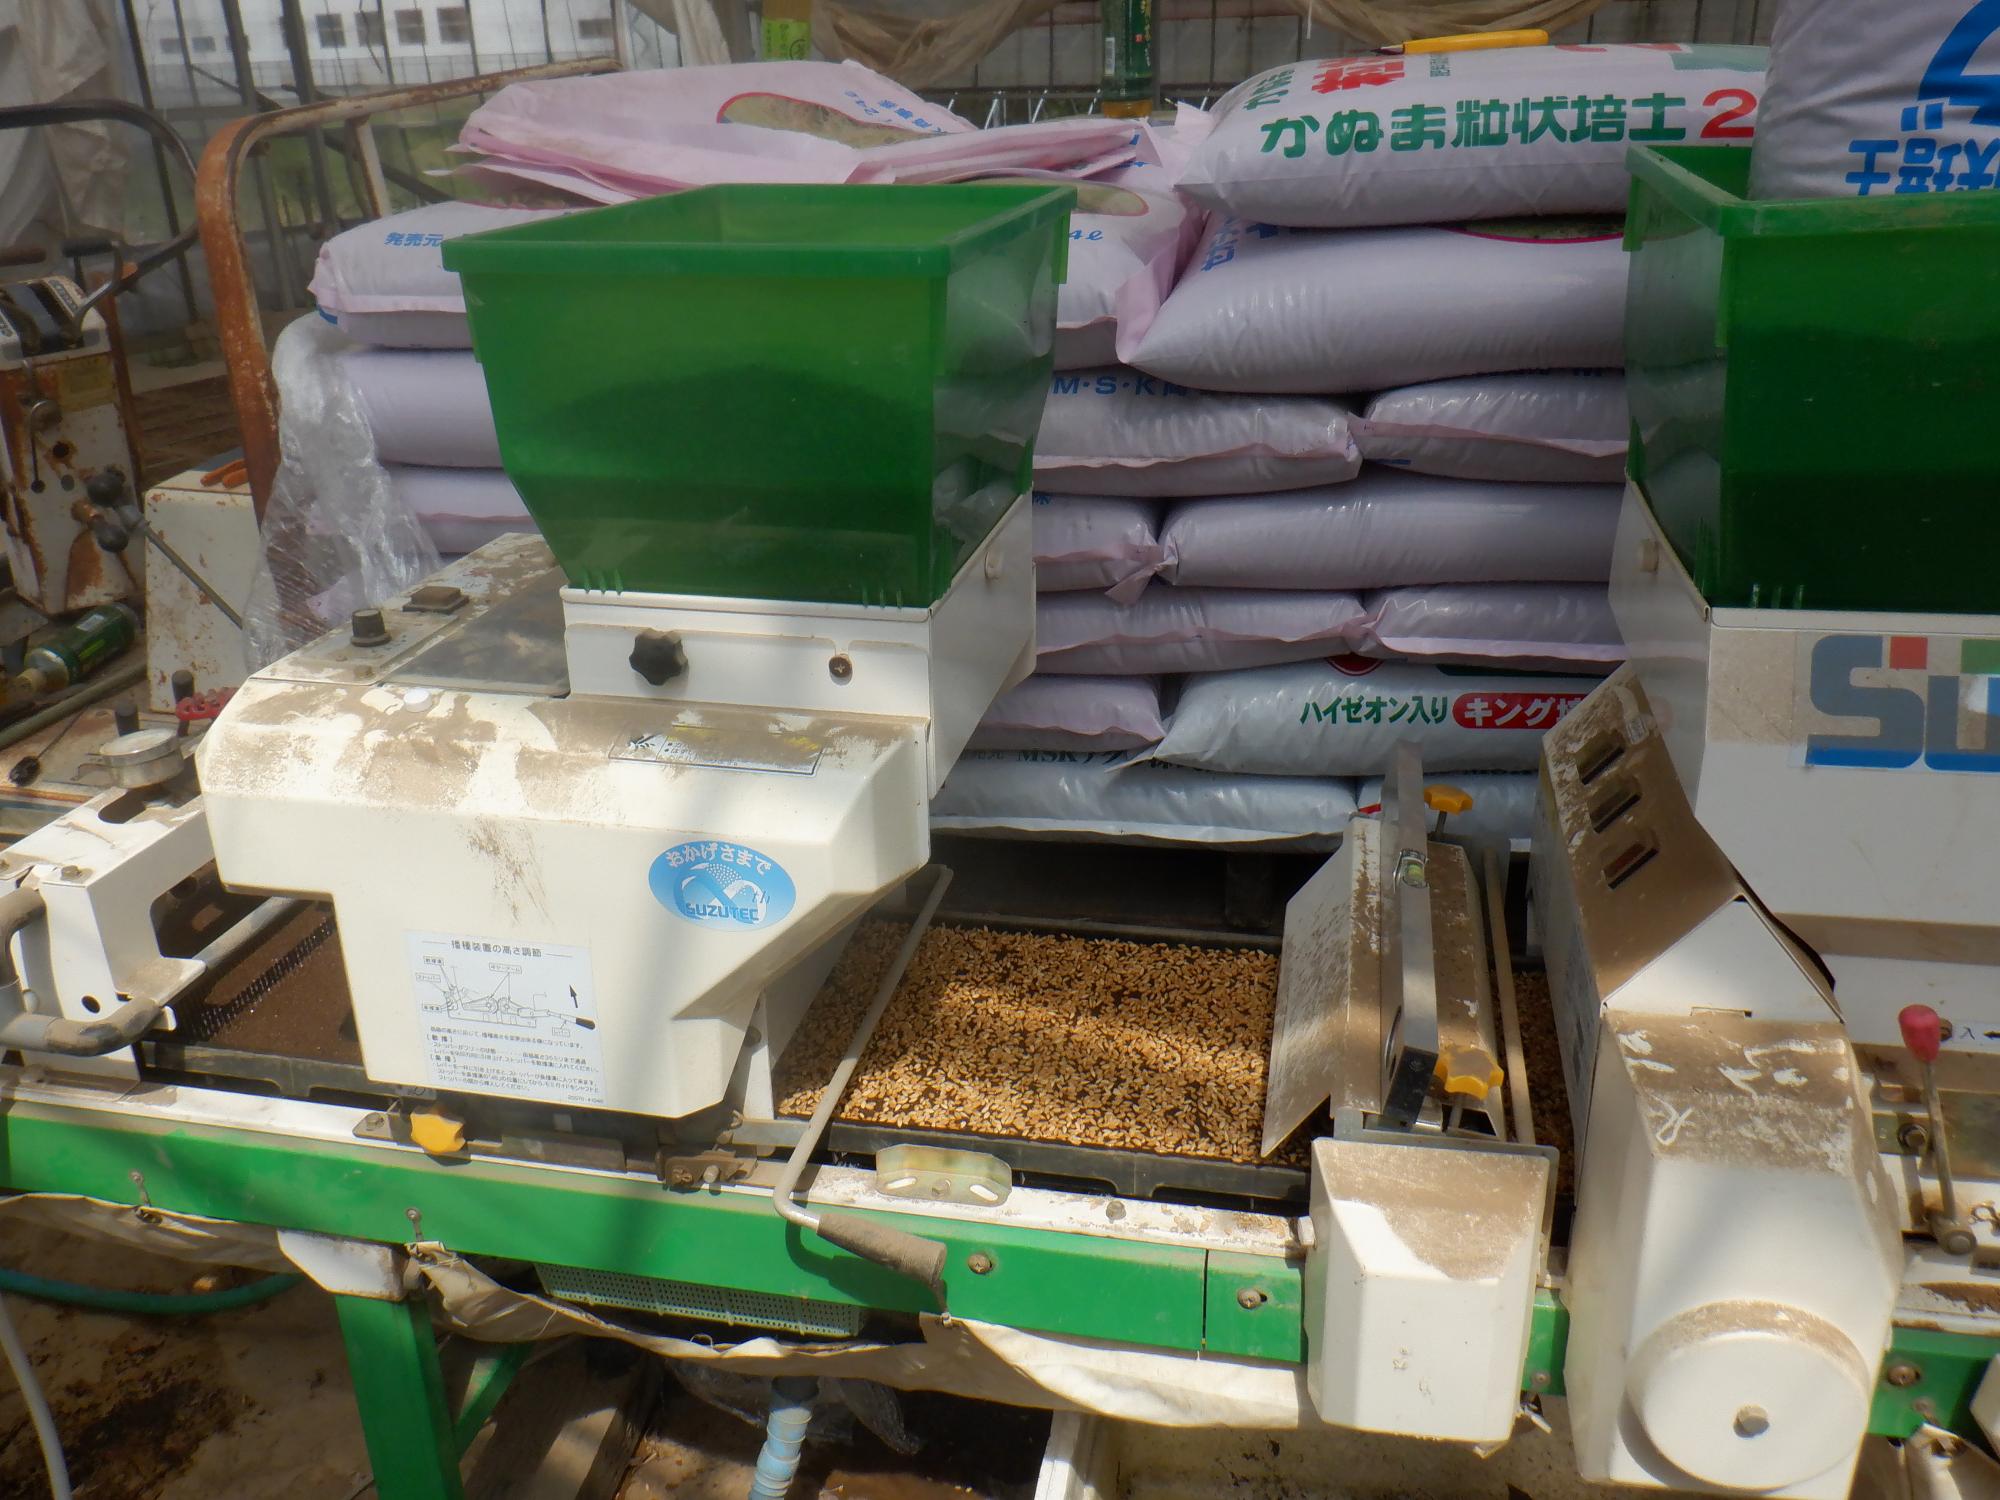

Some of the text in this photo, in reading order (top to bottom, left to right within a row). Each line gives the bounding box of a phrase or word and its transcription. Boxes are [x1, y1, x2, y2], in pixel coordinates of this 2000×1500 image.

[1300, 695, 1448, 725] ハイゼオン入り
[665, 842, 772, 876] おかげさまで
[685, 902, 760, 921] SUZUTEC
